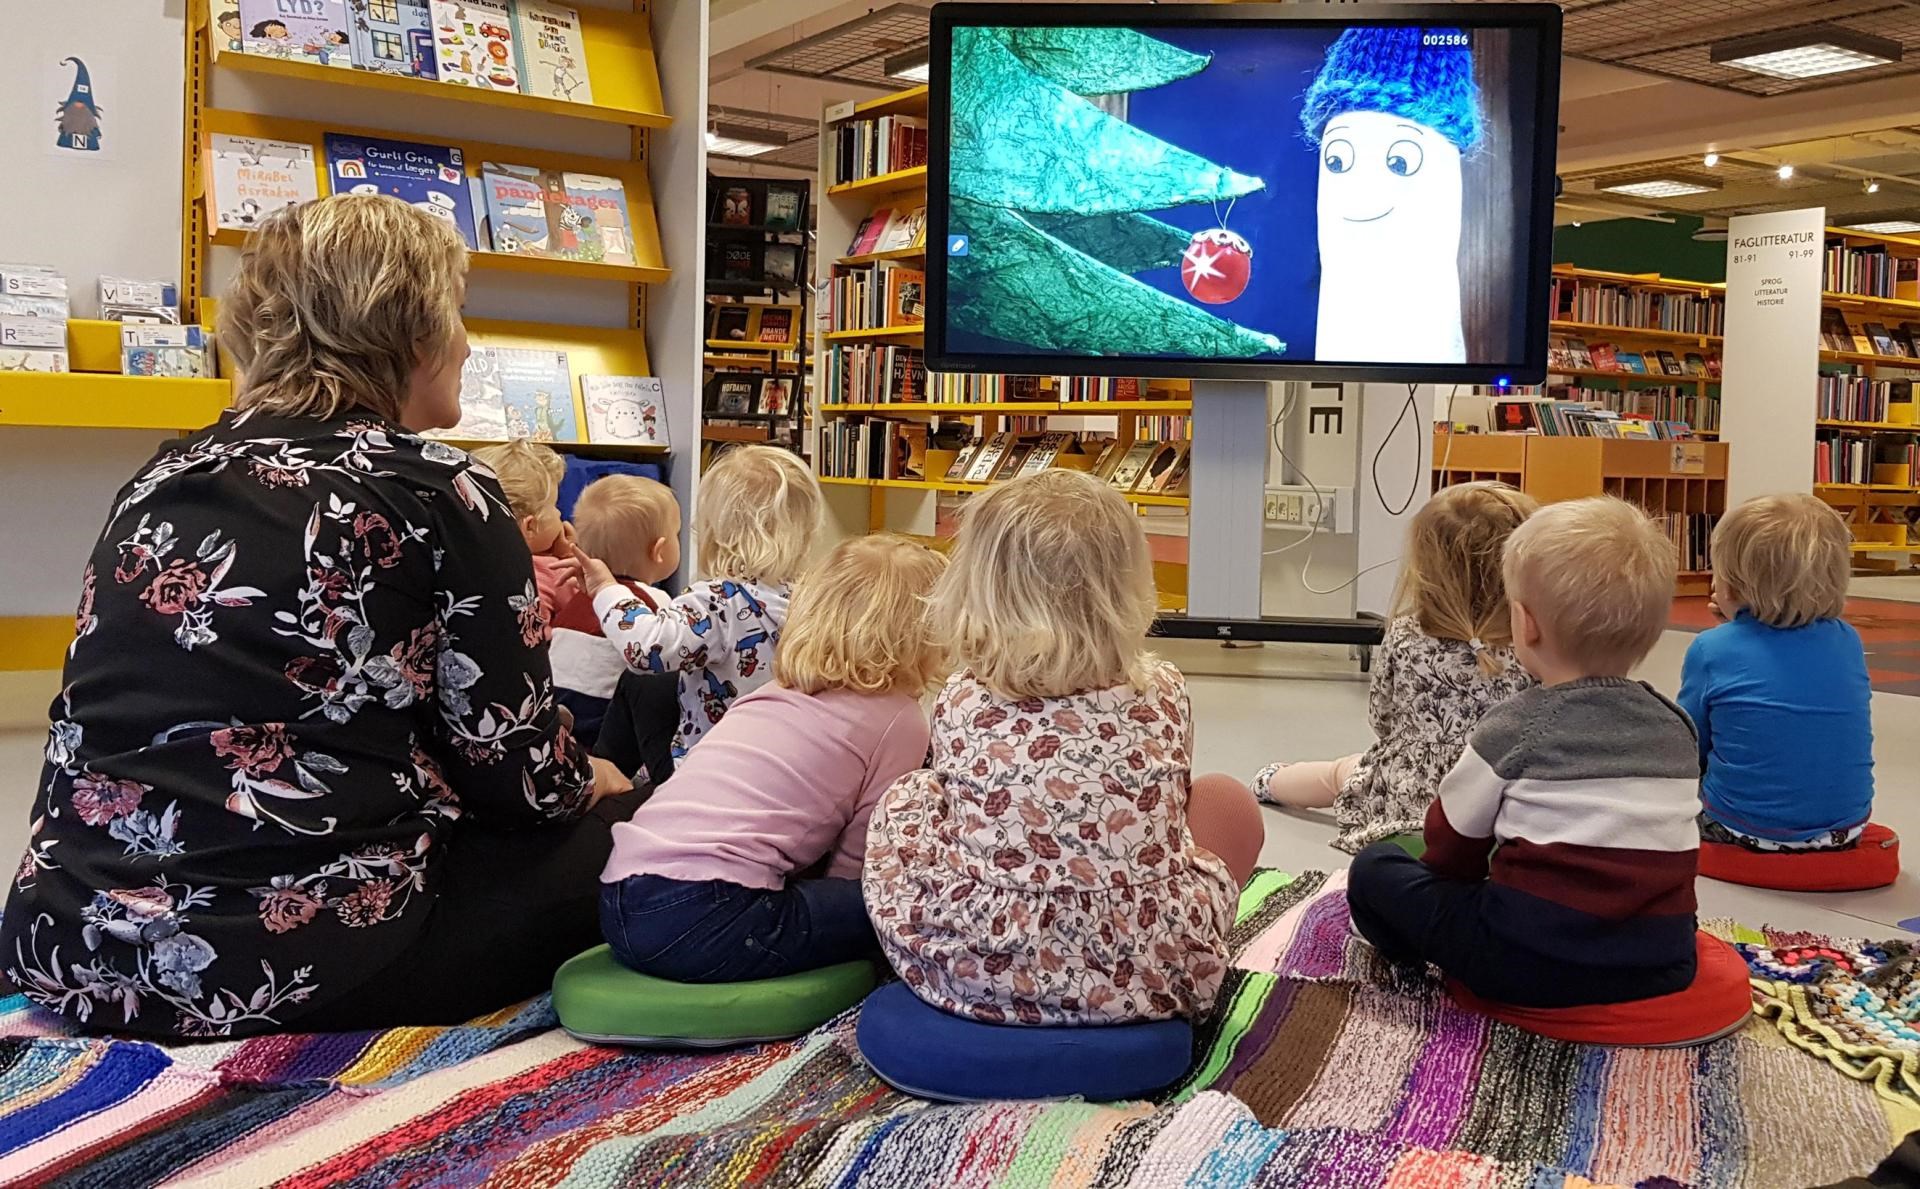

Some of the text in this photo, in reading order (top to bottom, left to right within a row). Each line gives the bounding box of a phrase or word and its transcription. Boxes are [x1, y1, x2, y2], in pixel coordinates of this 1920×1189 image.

[568, 10, 576, 20] T
[1423, 35, 1468, 46] 002586
[75, 135, 85, 147] N
[301, 148, 310, 158] T
[366, 146, 402, 161] Gurli
[405, 151, 433, 164] Gris
[452, 153, 461, 162] G
[405, 163, 436, 176] lægen
[495, 186, 618, 209] pandekager
[1734, 232, 1814, 248] FAGLITTERATUR
[1733, 249, 1814, 264] 81-91 91-99
[9, 278, 19, 289] S
[1761, 277, 1783, 286] SPROG
[104, 289, 115, 300] V
[1754, 288, 1788, 296] LITTERATUR
[1757, 298, 1784, 306] HISTORIE
[5, 328, 17, 340] R
[125, 331, 135, 343] T
[558, 355, 564, 365] F
[651, 383, 660, 392] C
[1041, 432, 1068, 442] KORT
